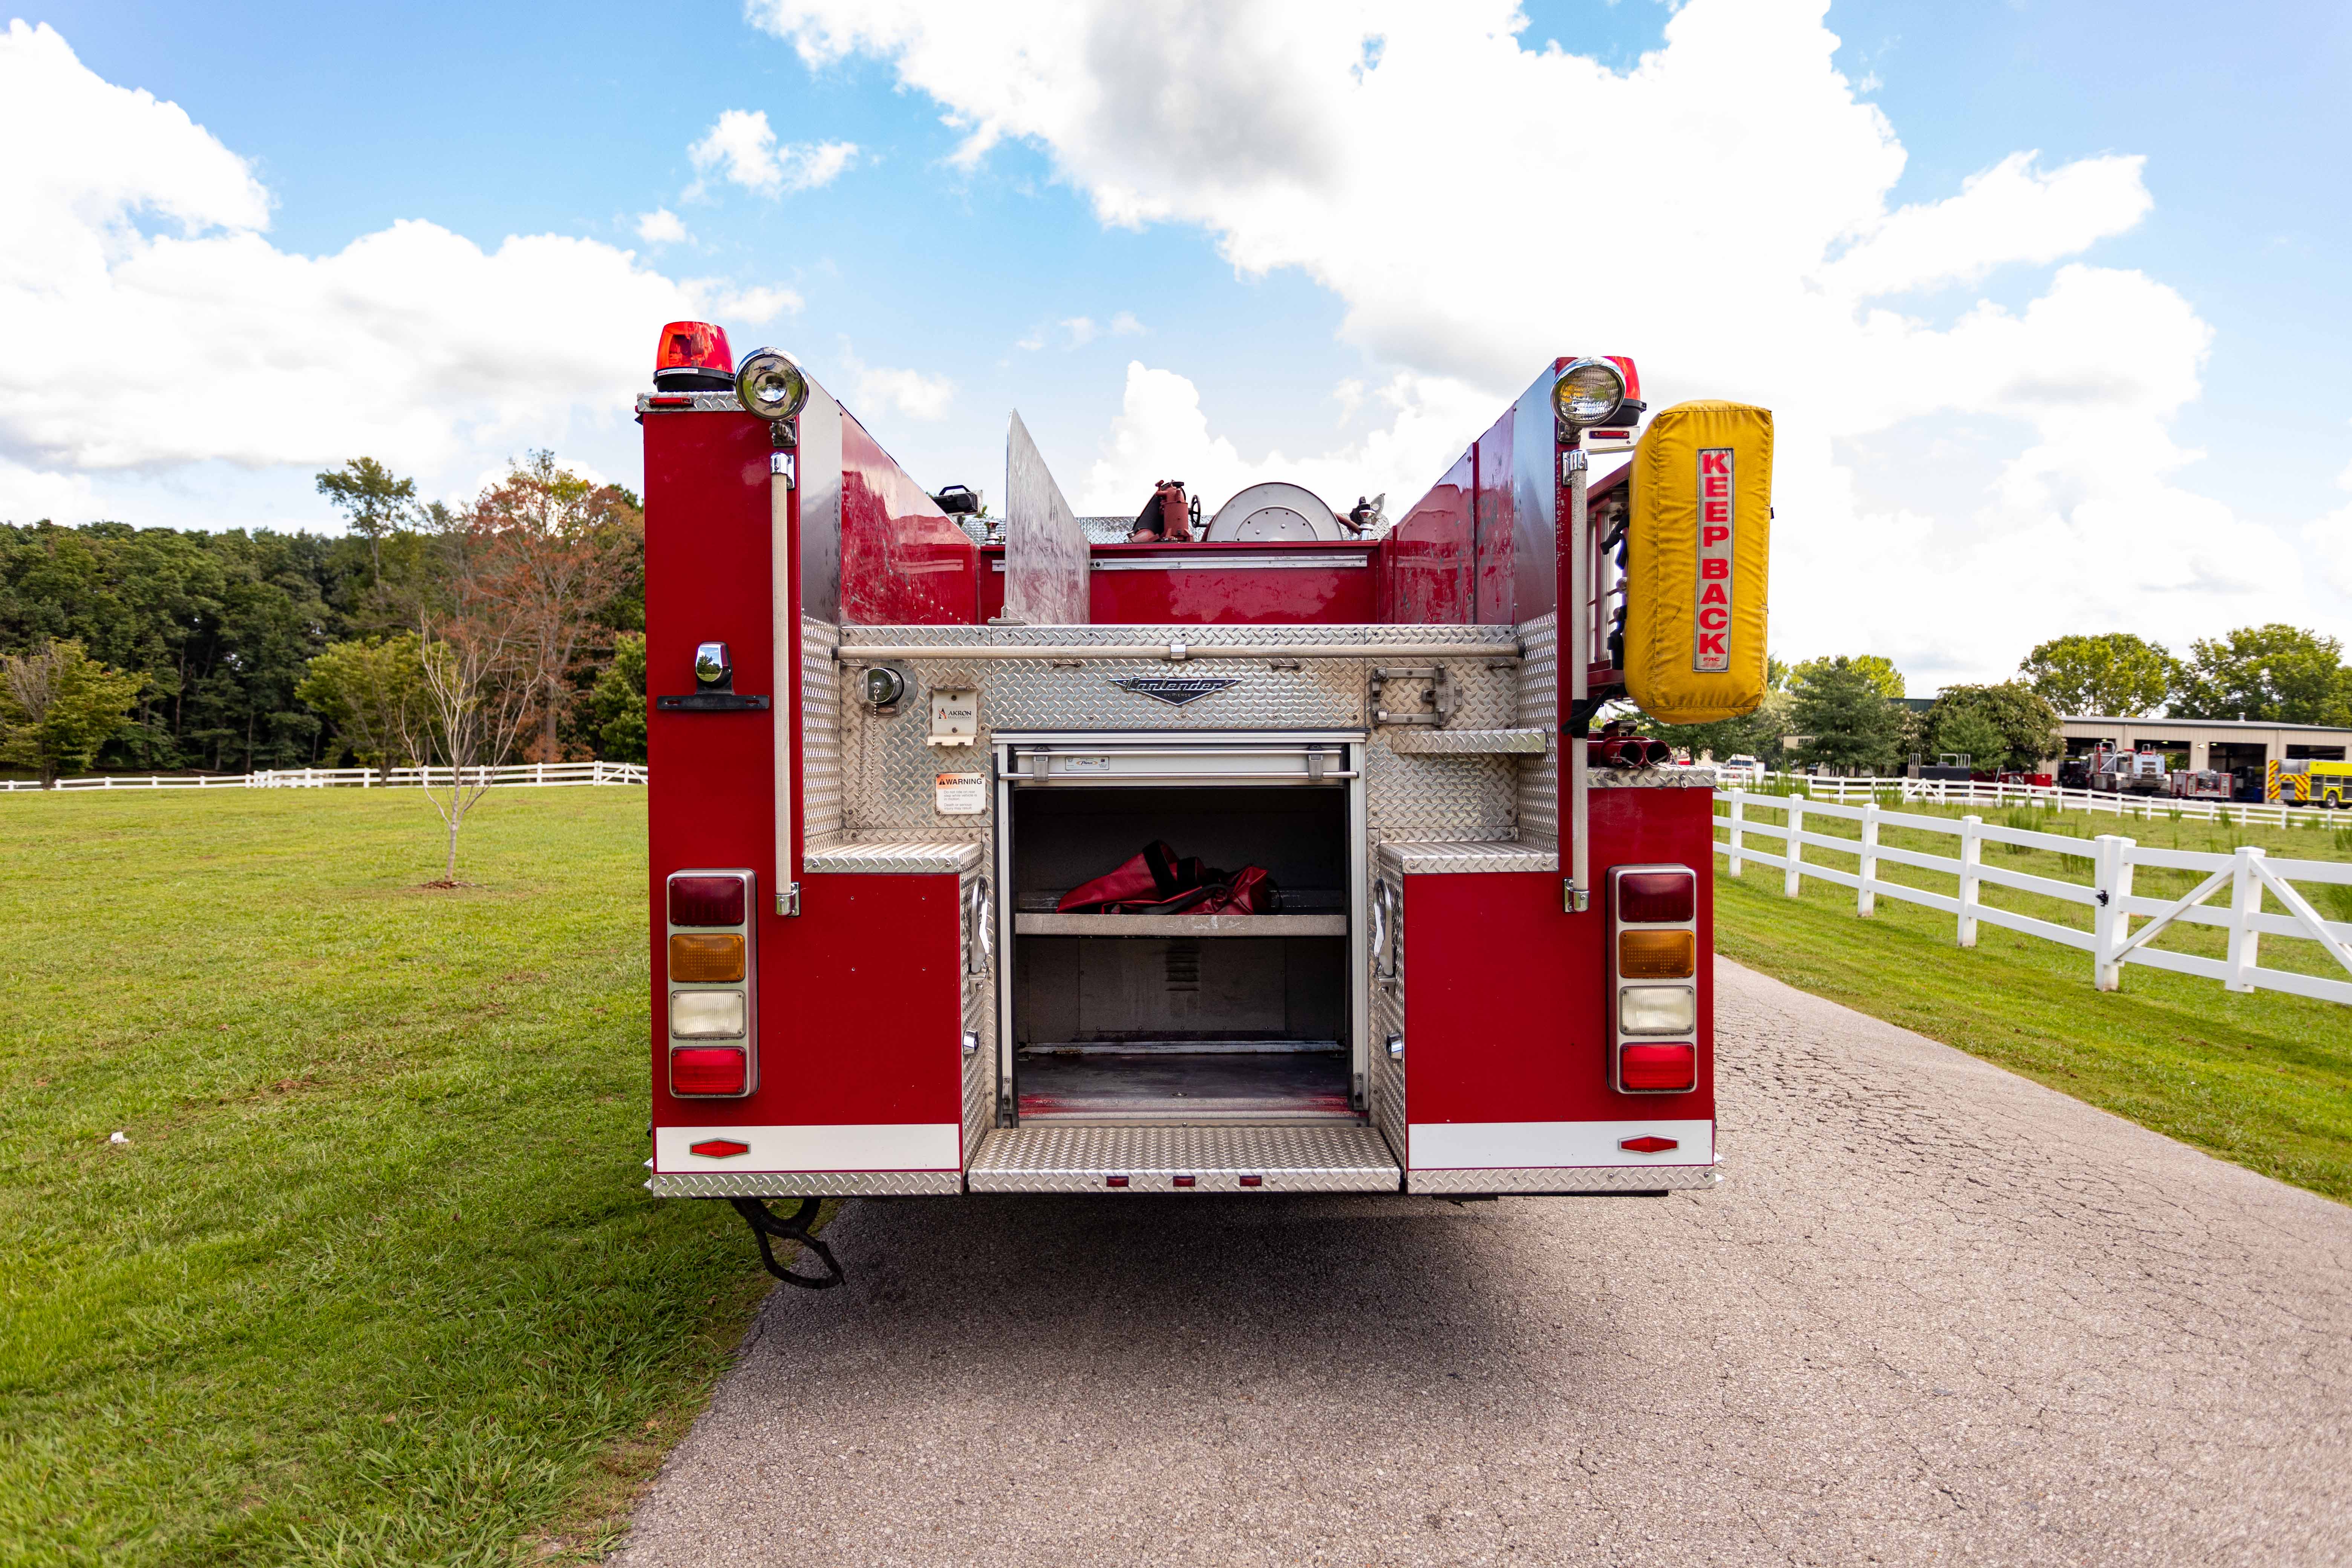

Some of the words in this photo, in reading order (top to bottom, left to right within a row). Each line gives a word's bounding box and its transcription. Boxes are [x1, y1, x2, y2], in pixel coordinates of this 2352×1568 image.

[1702, 453, 1730, 548] KEEP
[1699, 558, 1729, 654] BACK
[1124, 677, 1225, 691] Contender
